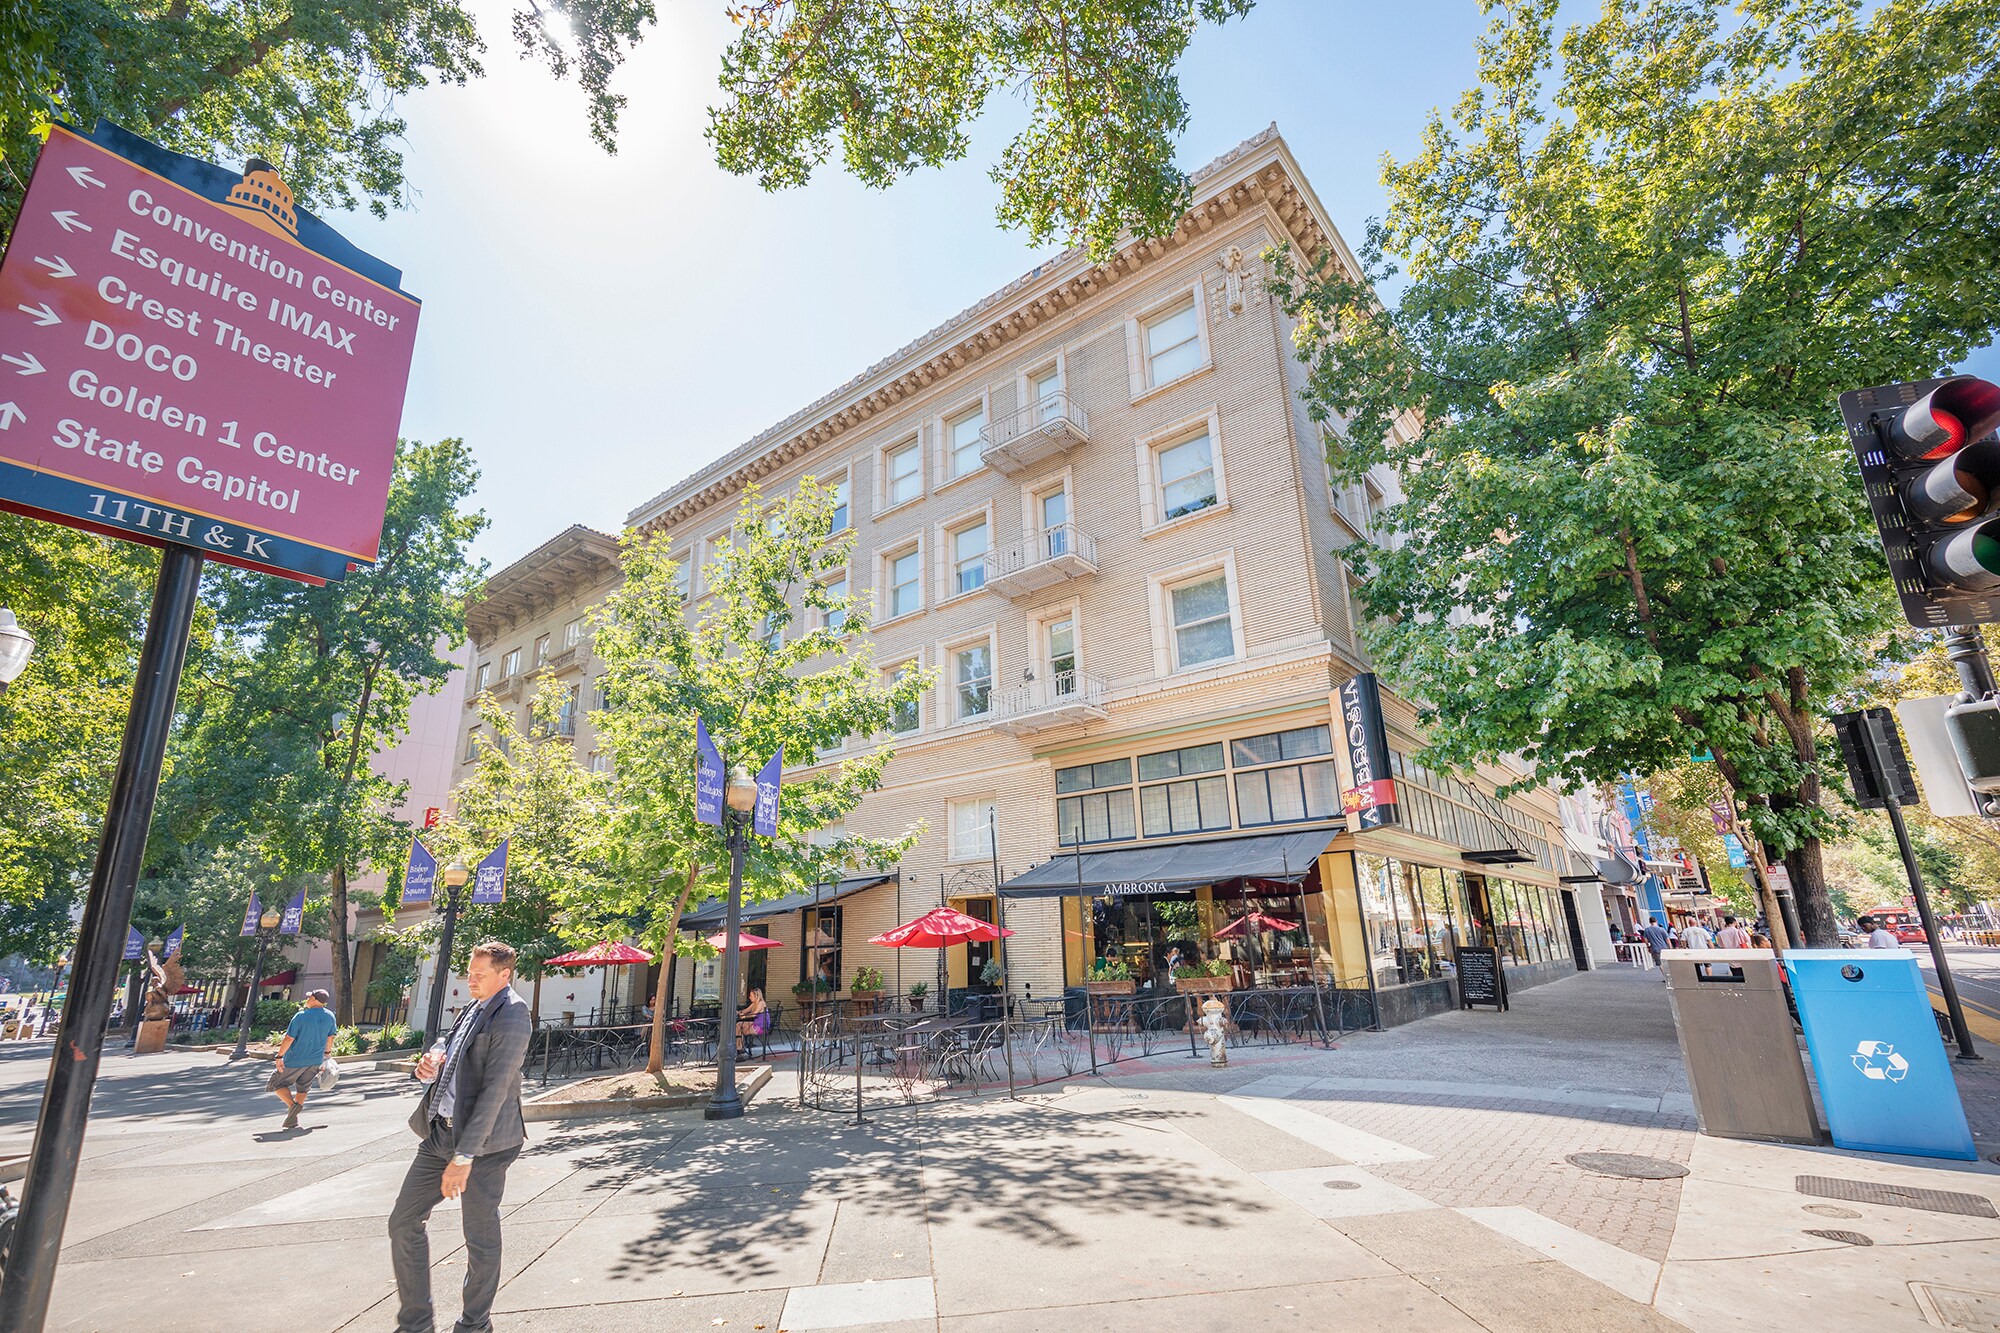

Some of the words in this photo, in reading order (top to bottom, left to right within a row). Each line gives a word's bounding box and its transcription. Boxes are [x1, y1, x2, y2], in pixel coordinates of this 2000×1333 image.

[127, 188, 304, 289] Convention
[312, 275, 399, 332] Center
[110, 229, 258, 312] Esquire
[268, 297, 358, 356] IMAX
[84, 320, 198, 382] DOCO
[97, 274, 202, 338] Crest
[213, 318, 336, 389] Theater
[68, 369, 207, 436] Golden
[218, 421, 242, 449] 1
[253, 431, 360, 486] Center
[52, 418, 164, 474] State
[176, 456, 301, 514] Capitol
[87, 493, 195, 539] 11TH
[203, 525, 234, 549] &
[243, 532, 273, 559] K
[1344, 678, 1378, 824] AMBROSIA
[698, 780, 722, 799] Gallegos
[698, 799, 716, 814] Square
[404, 887, 427, 896] Square
[407, 874, 433, 886] Gallegos
[409, 862, 429, 874] Bishop
[1103, 881, 1167, 895] AMBROSIA
